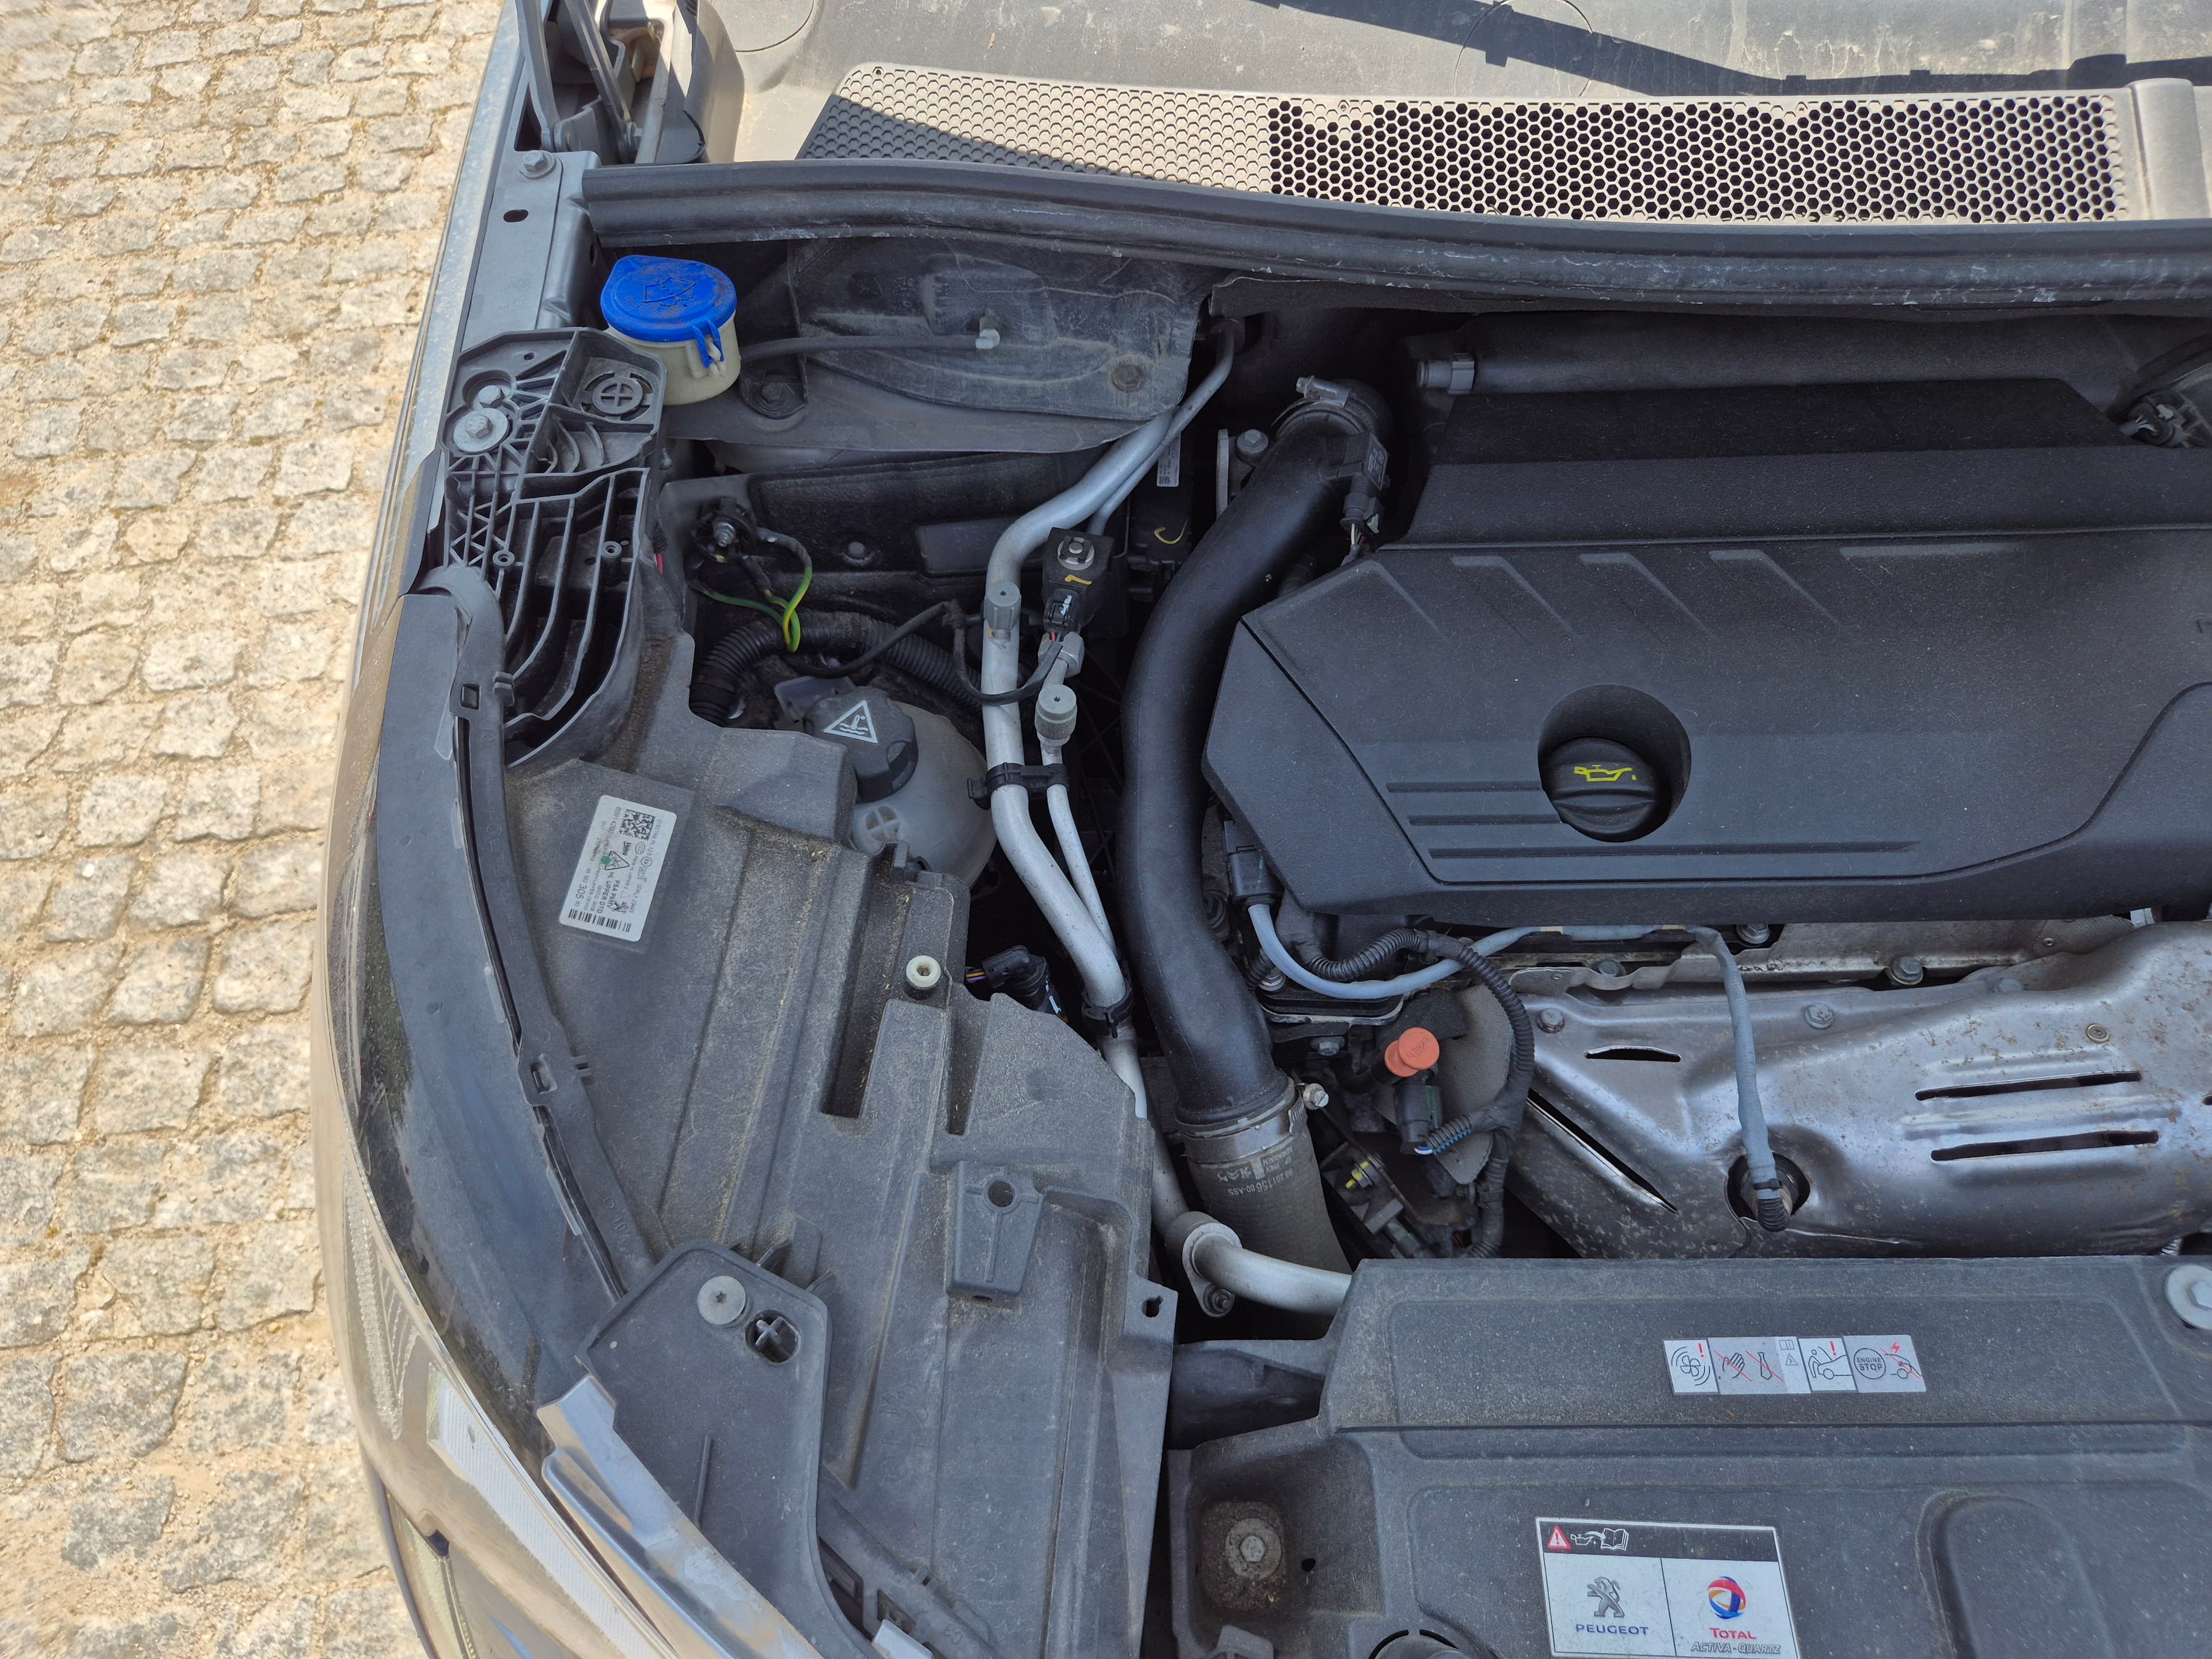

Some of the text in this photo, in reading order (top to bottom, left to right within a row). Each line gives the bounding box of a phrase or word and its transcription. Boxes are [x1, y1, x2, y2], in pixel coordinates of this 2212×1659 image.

[607, 872, 614, 880] HL
[601, 880, 611, 900] UPPER
[612, 880, 620, 891] PSA
[575, 884, 587, 899] 305
[1575, 1624, 1649, 1635] PEUGEOT
